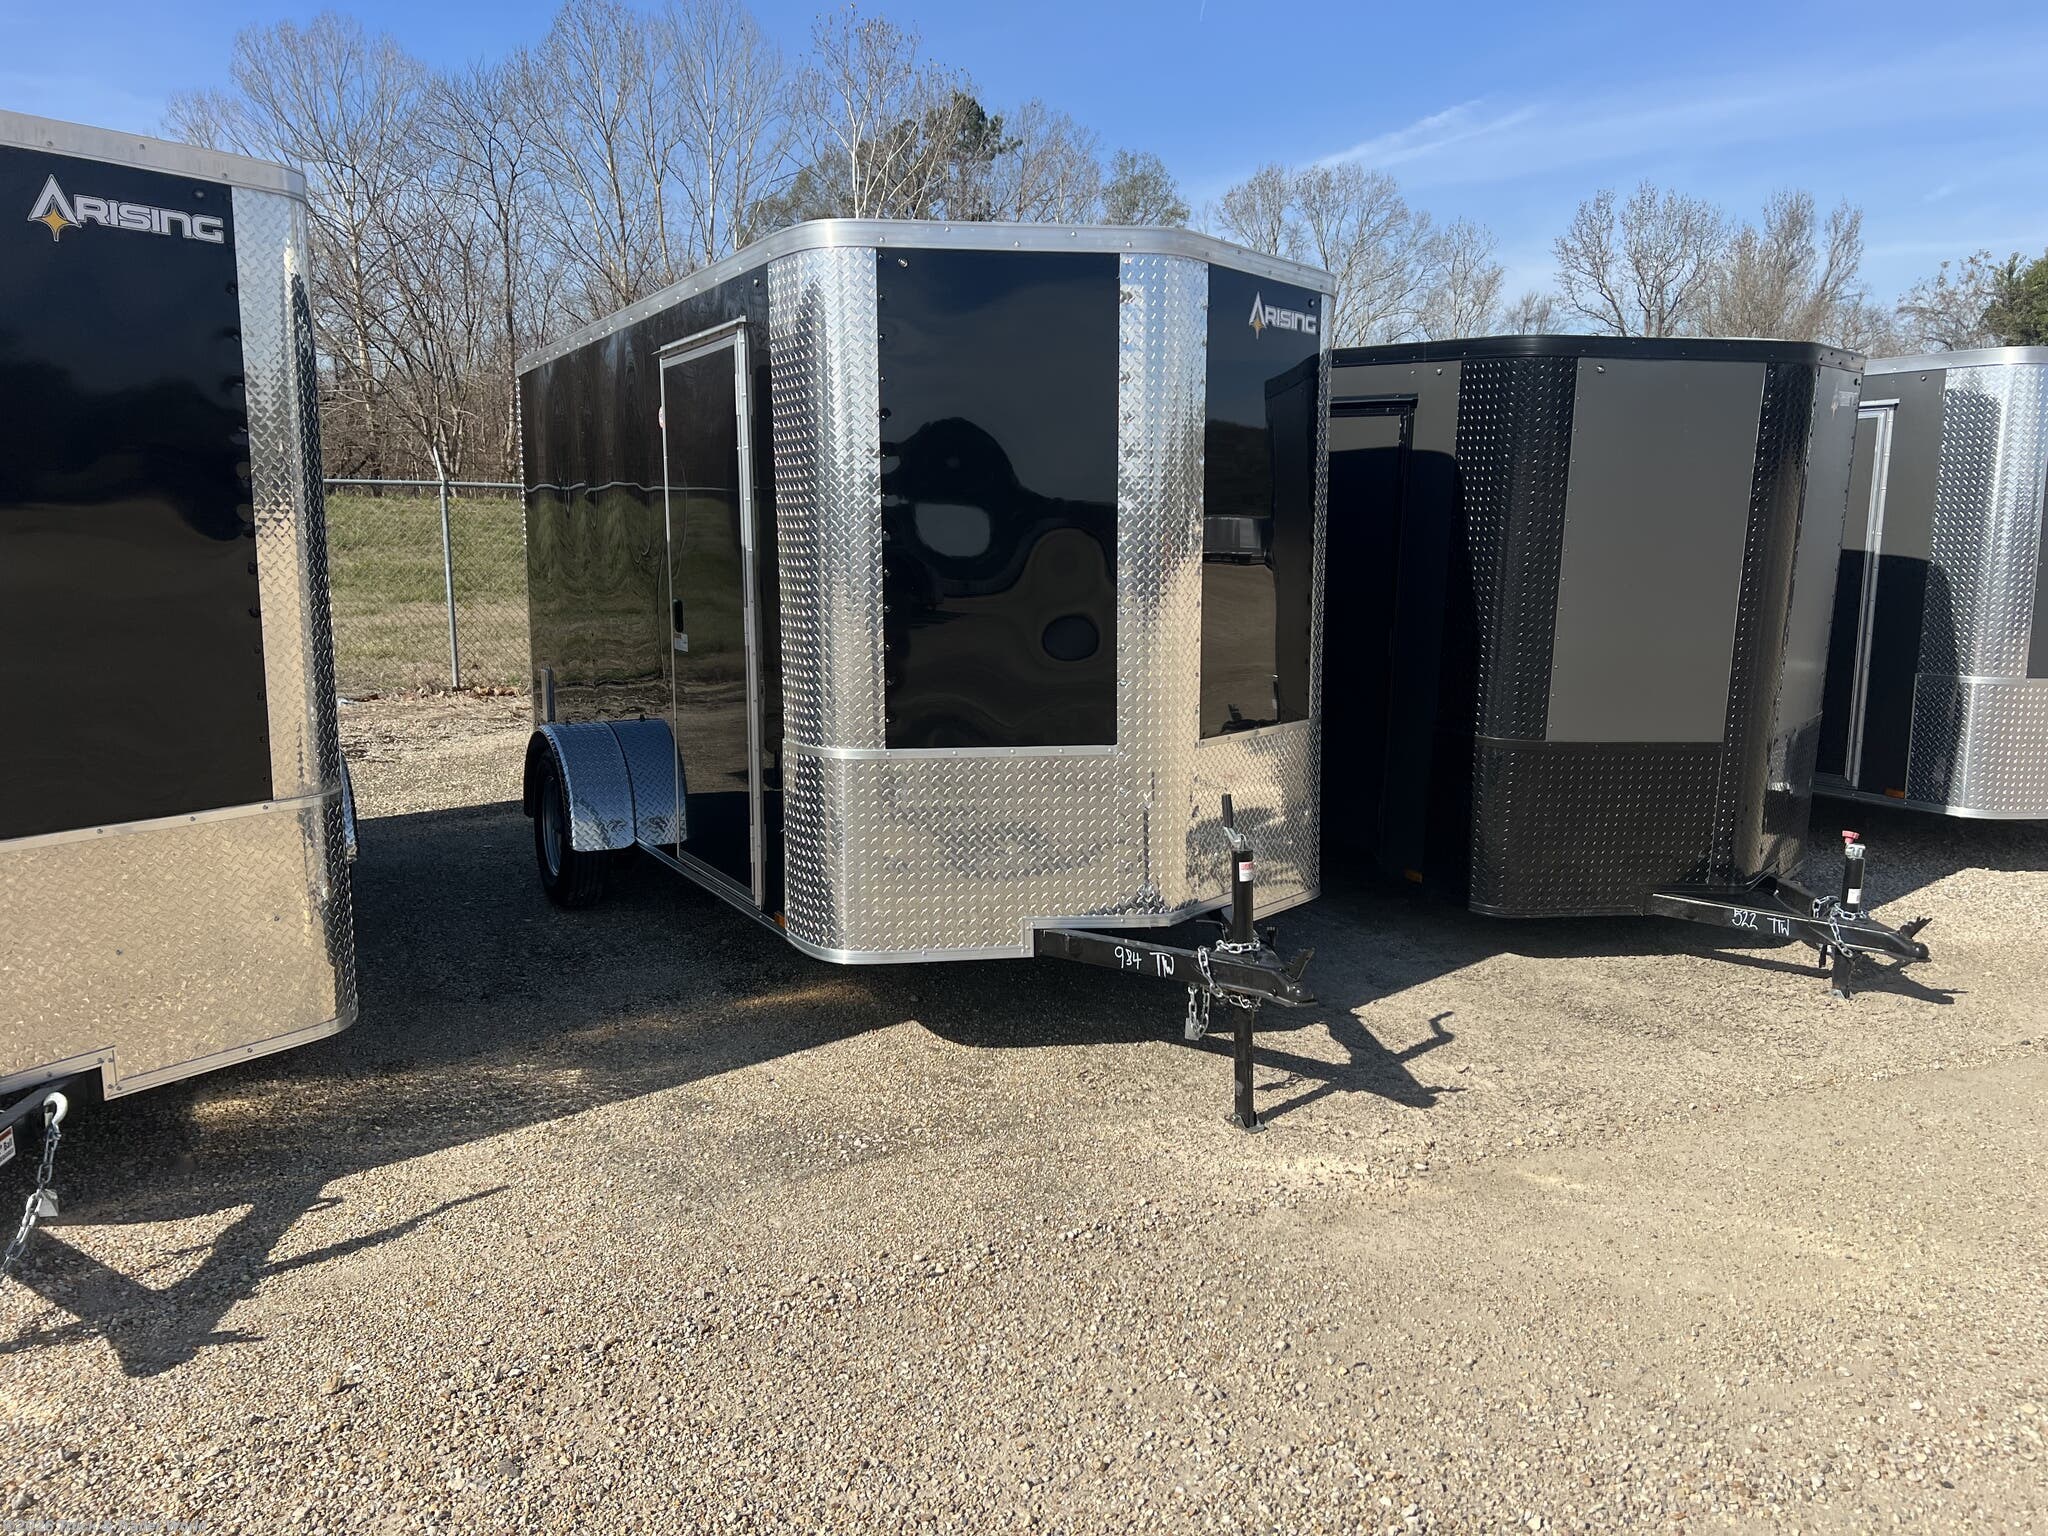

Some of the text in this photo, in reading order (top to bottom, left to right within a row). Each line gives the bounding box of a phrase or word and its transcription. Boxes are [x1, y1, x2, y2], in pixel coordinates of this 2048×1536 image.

[27, 174, 225, 243] ARISING
[1248, 290, 1318, 336] ARISING
[1731, 908, 1759, 931] 522
